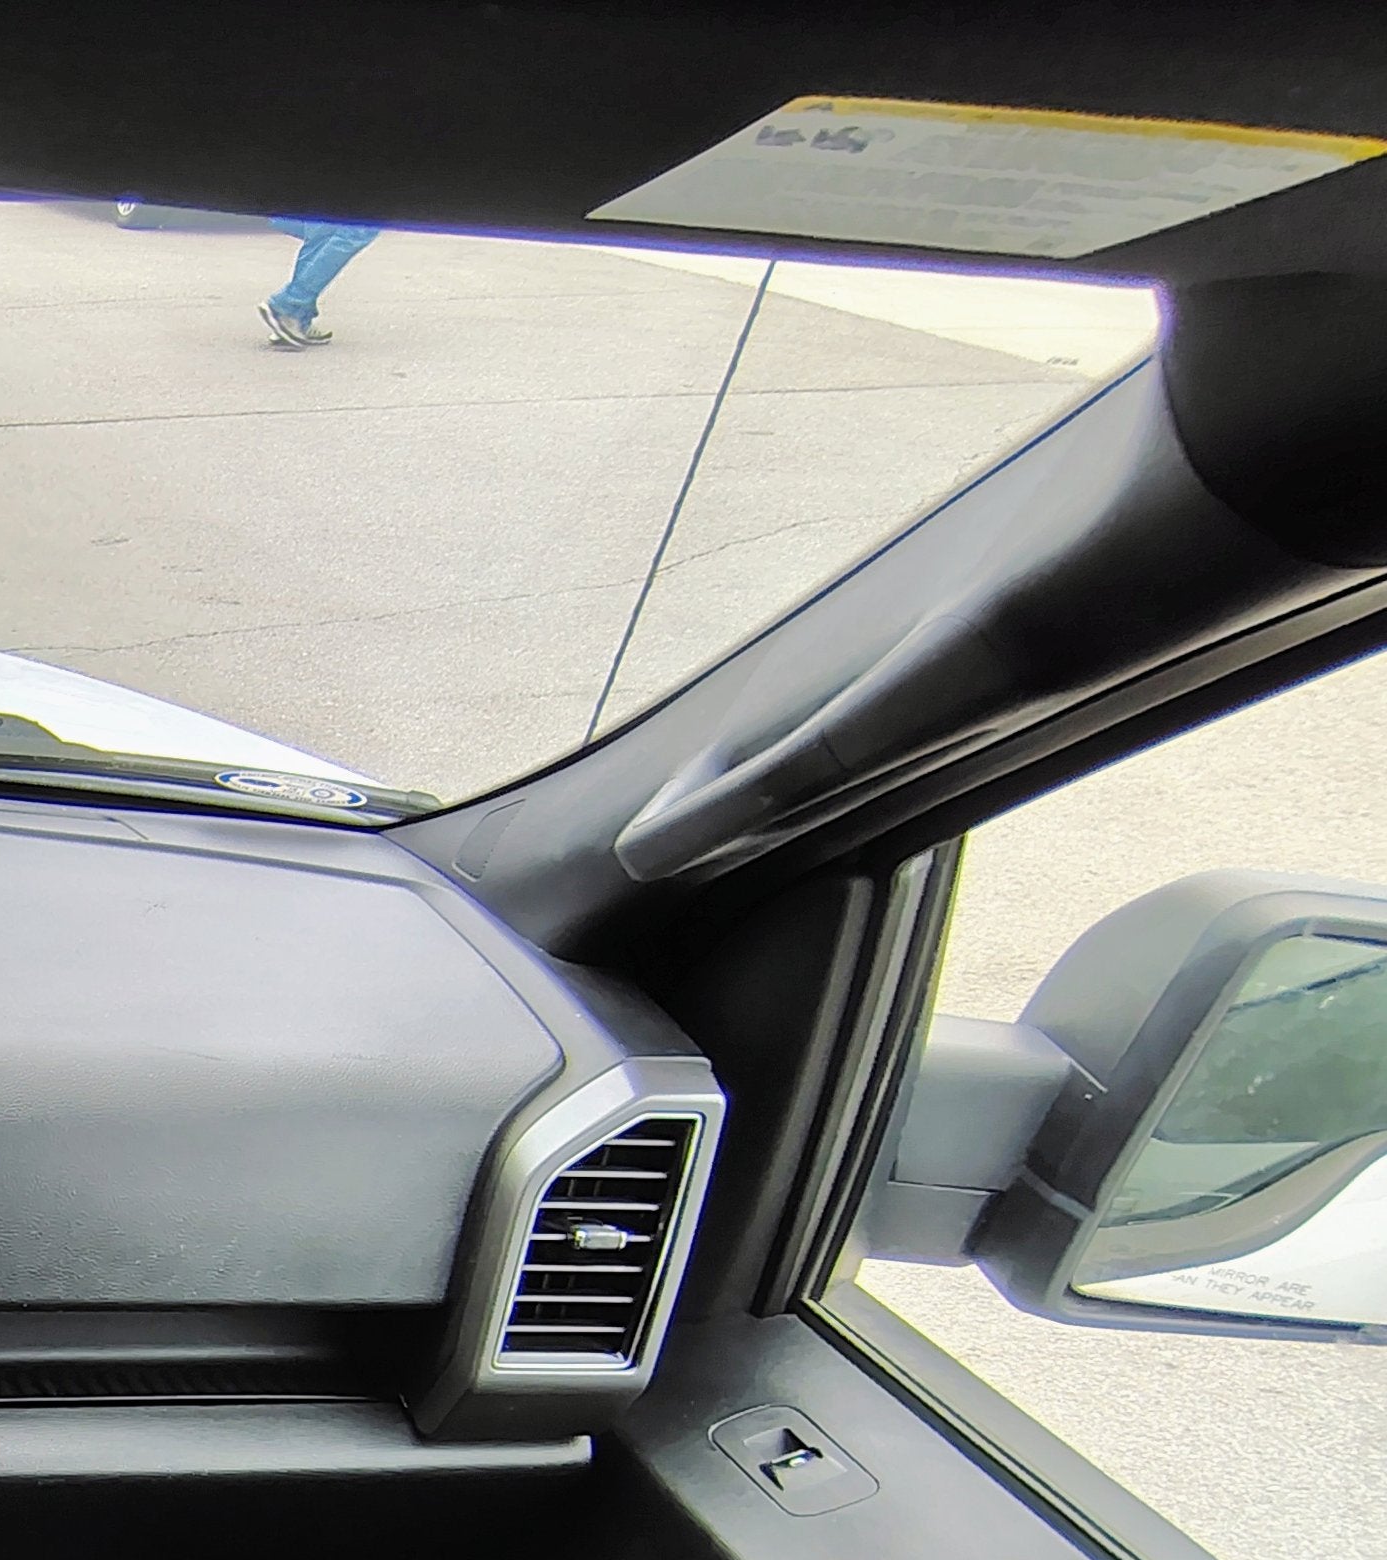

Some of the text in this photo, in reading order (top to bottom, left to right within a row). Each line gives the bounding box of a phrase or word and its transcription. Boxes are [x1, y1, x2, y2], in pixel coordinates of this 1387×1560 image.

[1205, 1279, 1245, 1296] THEY
[1248, 1291, 1316, 1312] APPEAR
[1208, 1266, 1313, 1297] MIRROR ARE
